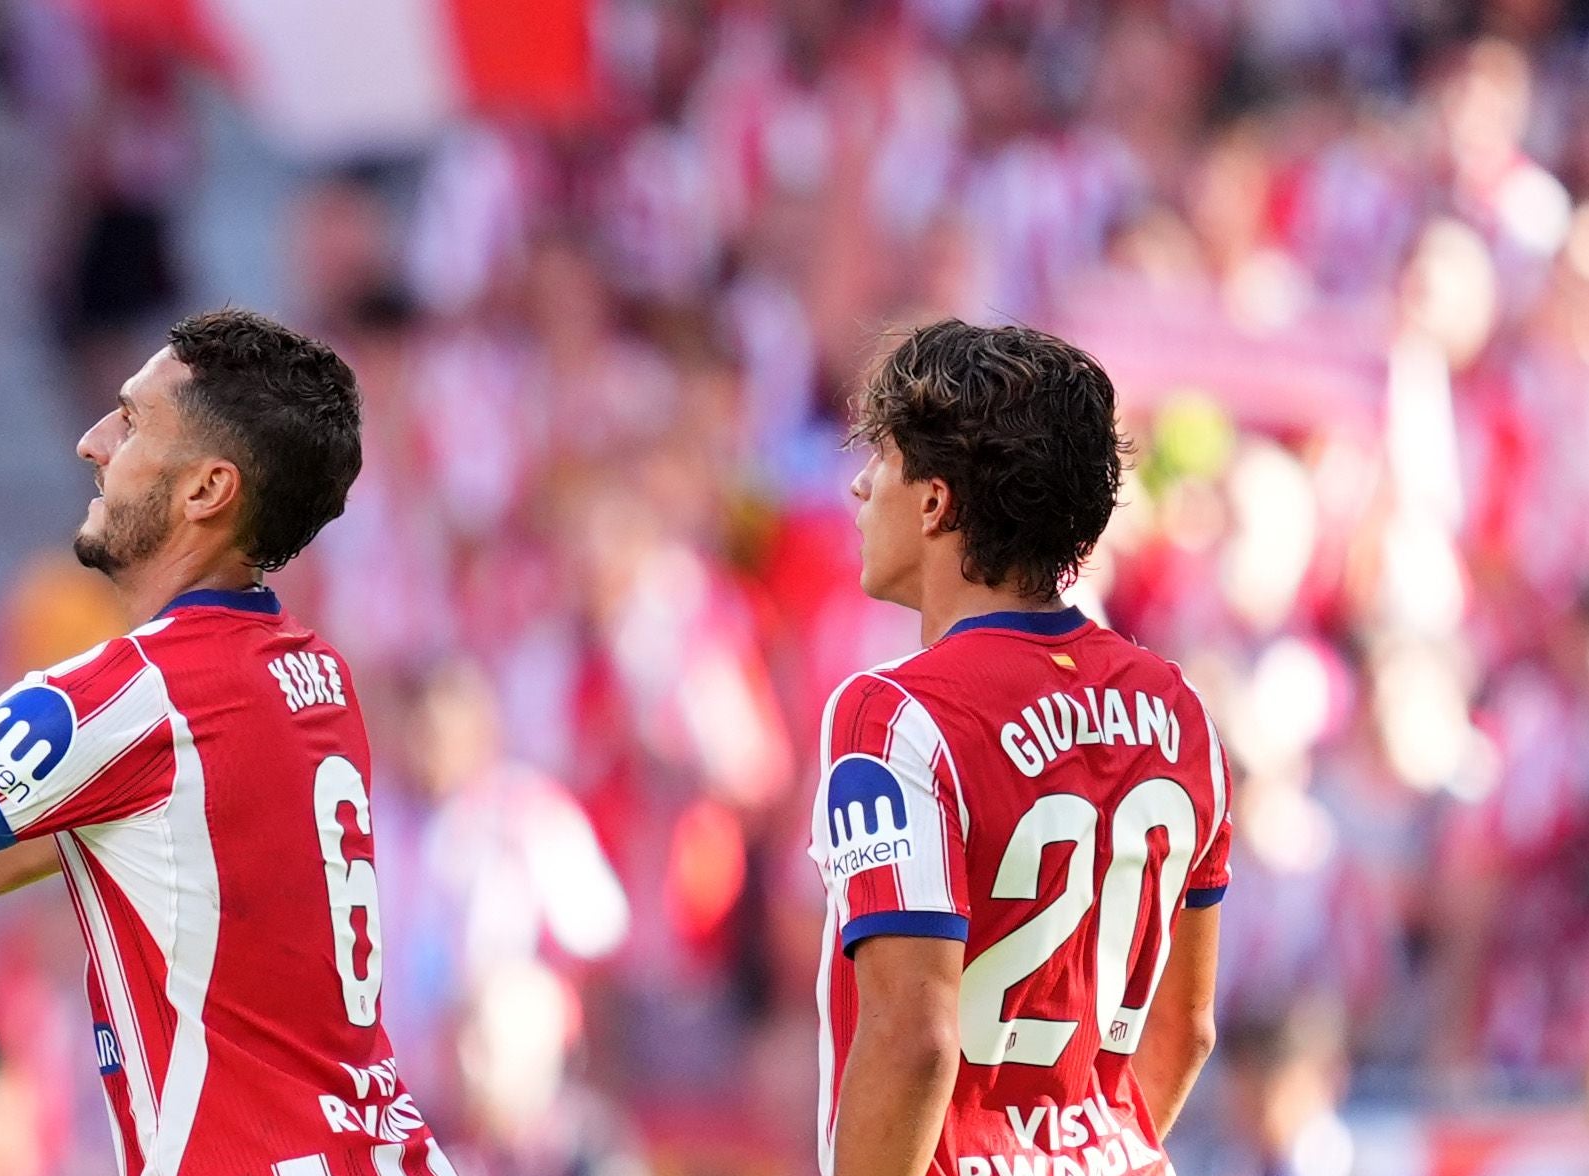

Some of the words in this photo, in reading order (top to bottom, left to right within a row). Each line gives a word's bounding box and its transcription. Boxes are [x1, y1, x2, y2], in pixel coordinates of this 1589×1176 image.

[267, 651, 347, 713] KOKE
[1000, 687, 1180, 778] GIULIANO
[313, 754, 383, 1027] 6
[833, 838, 911, 877] kraken
[958, 777, 1198, 1067] 20
[94, 1030, 120, 1067] IR
